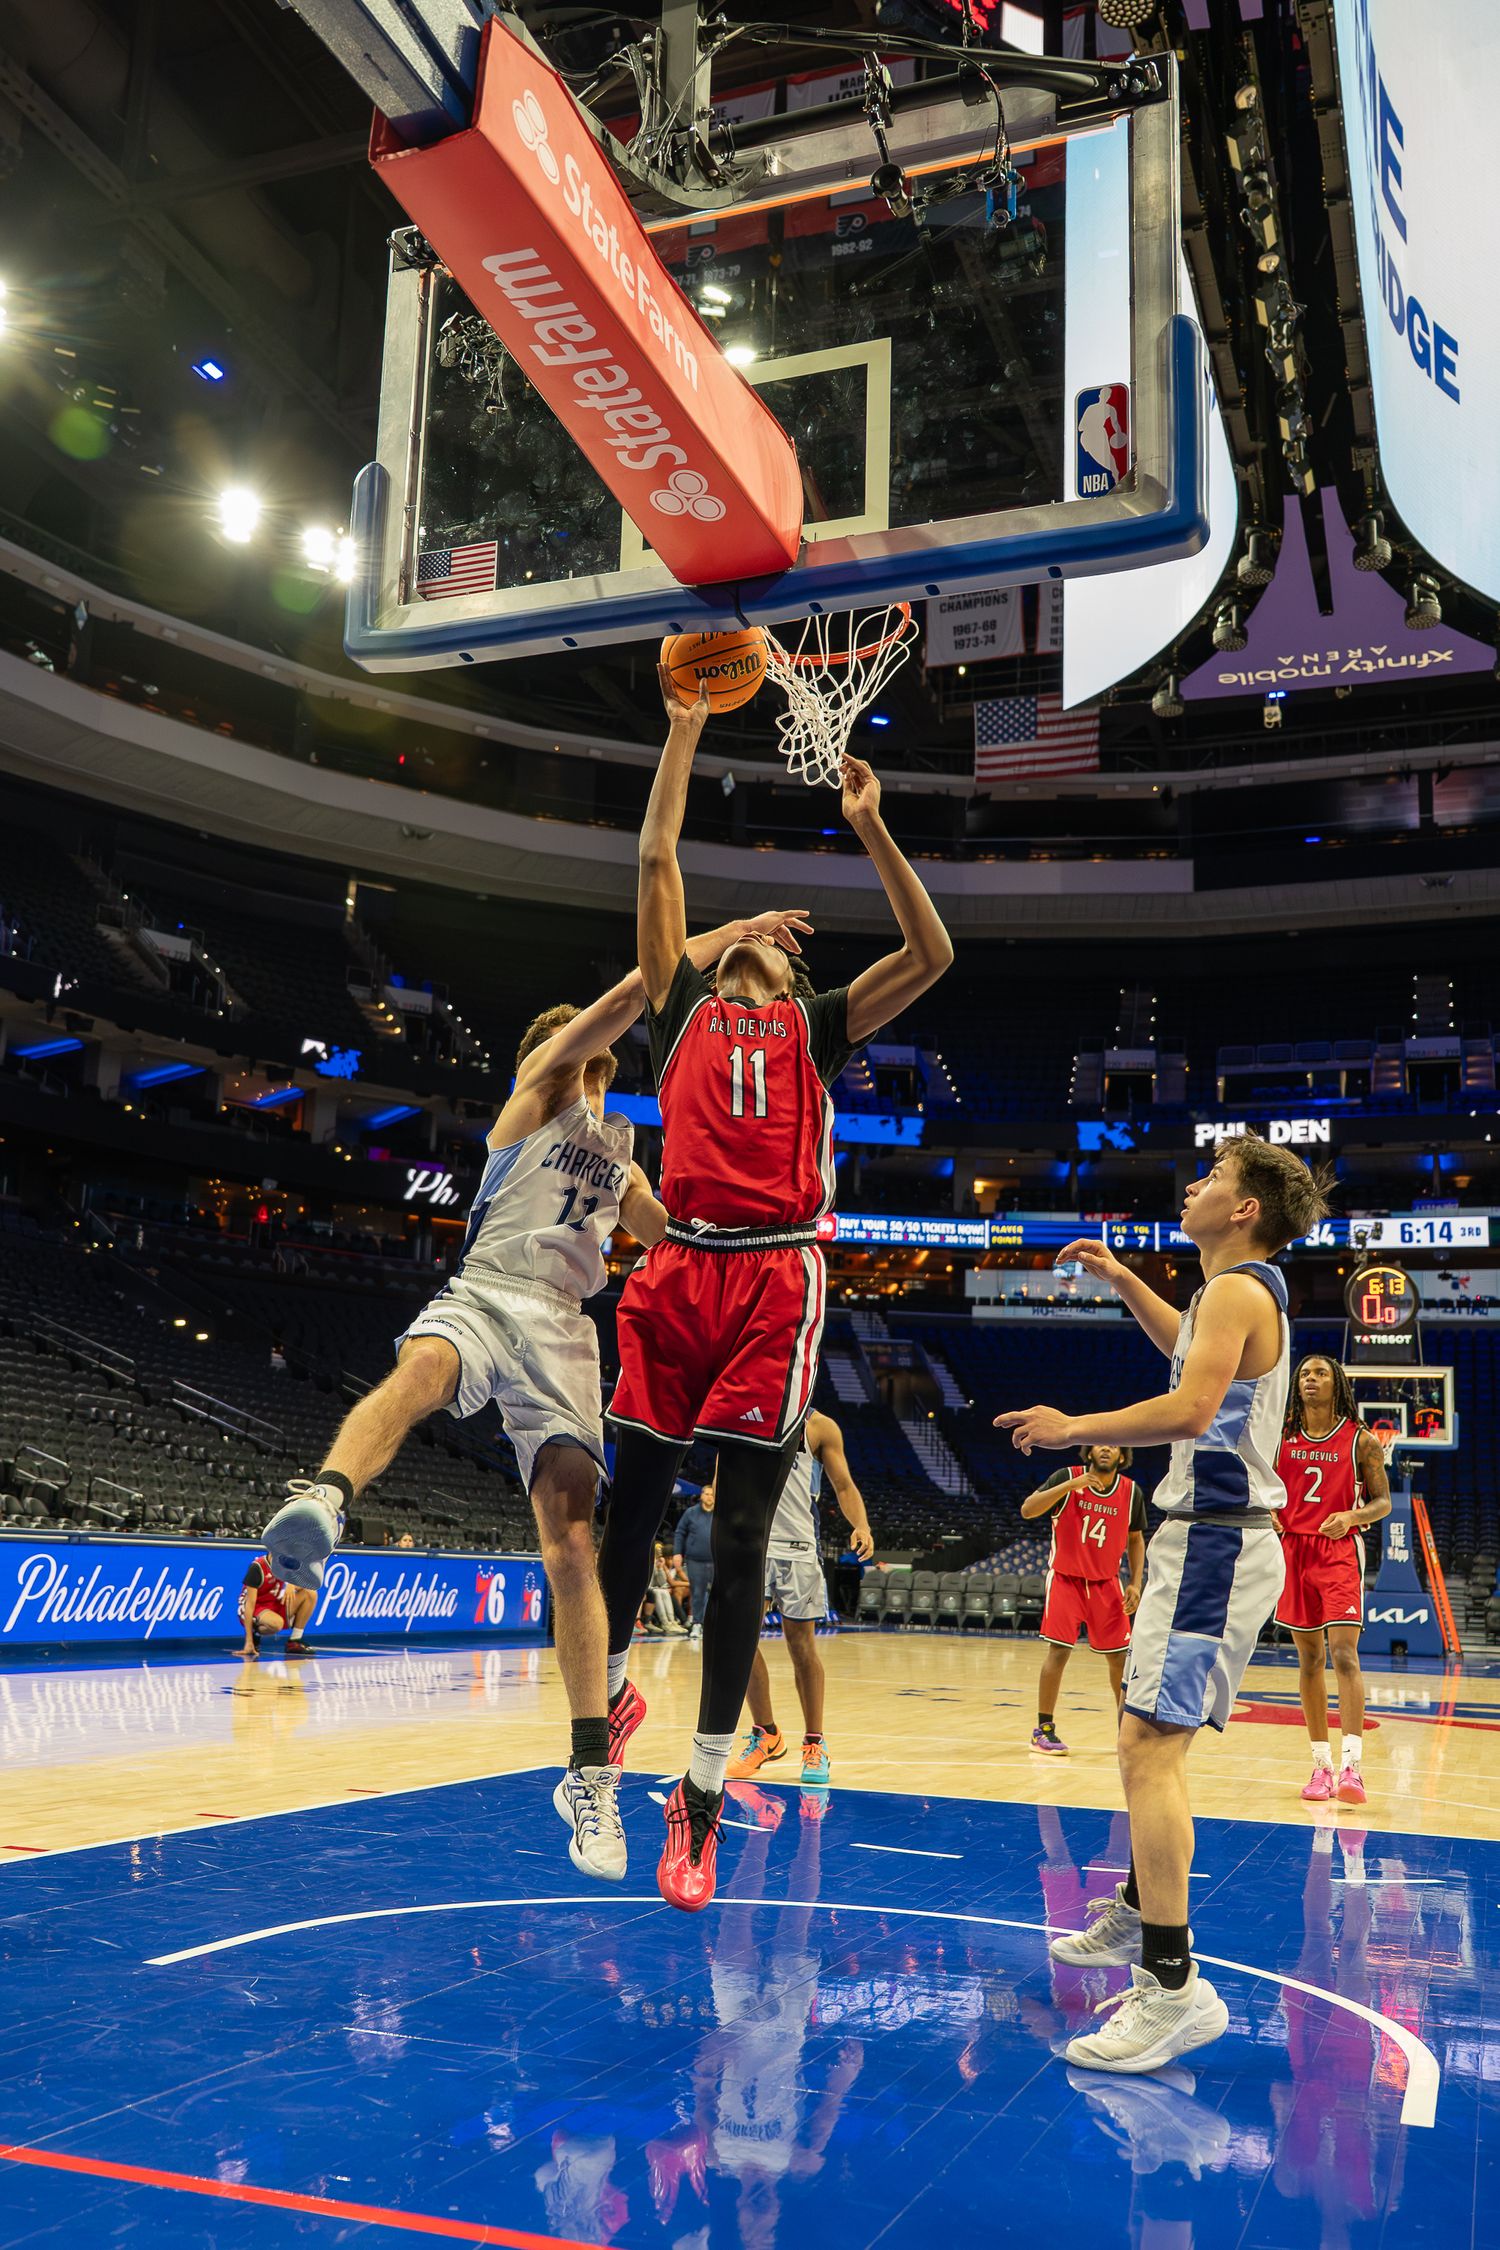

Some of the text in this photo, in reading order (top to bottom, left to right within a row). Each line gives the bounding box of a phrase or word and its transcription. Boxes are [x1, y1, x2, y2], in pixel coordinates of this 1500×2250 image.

[1083, 472, 1109, 494] NBA
[939, 593, 1009, 614] CHAMPIONS
[953, 619, 997, 637] 1967-68
[954, 634, 996, 650] 1973-74
[693, 652, 761, 680] Wilson
[1277, 645, 1388, 666] ARENA
[1218, 664, 1332, 687] mobile
[728, 1044, 768, 1118] 11
[1269, 1118, 1330, 1144] DEN
[839, 1218, 860, 1230] BUY
[861, 1219, 888, 1231] YOUR
[889, 1220, 921, 1233] 50/50
[921, 1222, 957, 1234] TICKETS
[1400, 1221, 1482, 1244] 6:14 3RD
[1114, 1235, 1147, 1248] 0 7
[1368, 1278, 1405, 1295] 6:13
[1369, 1334, 1413, 1345] TISSOT
[1291, 1449, 1339, 1462] RED DEVILS
[1303, 1466, 1323, 1503] 2
[1079, 1499, 1118, 1516] RED DEVILS
[1081, 1514, 1106, 1548] 14
[1390, 1522, 1405, 1535] GET
[1390, 1535, 1405, 1548] THE
[2, 1553, 224, 1640] Philadelphia
[315, 1562, 506, 1632] Philadelphia 76
[522, 1586, 542, 1622] 76
[1368, 1607, 1428, 1624] KIA
